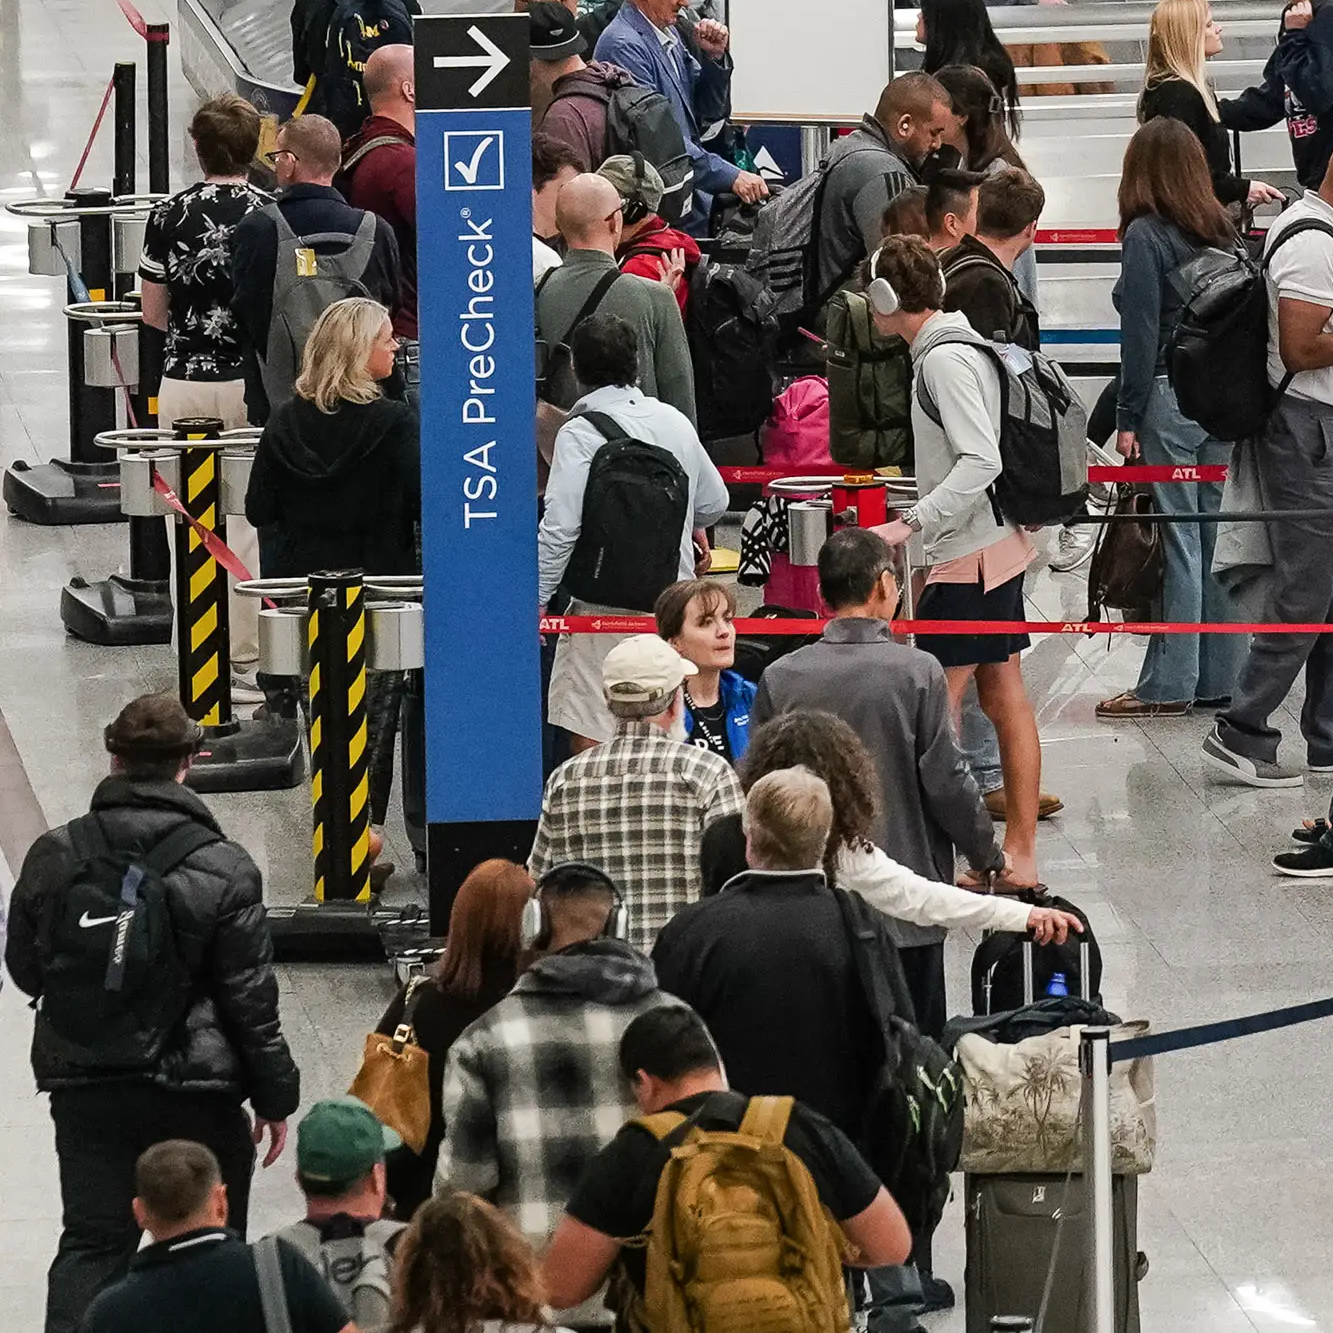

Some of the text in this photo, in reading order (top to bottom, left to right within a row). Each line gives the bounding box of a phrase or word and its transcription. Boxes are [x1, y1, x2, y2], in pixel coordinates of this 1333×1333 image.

[1172, 468, 1201, 480] ATL
[463, 440, 498, 529] TSA
[539, 618, 570, 630] ATL
[1061, 622, 1093, 633] ATL
